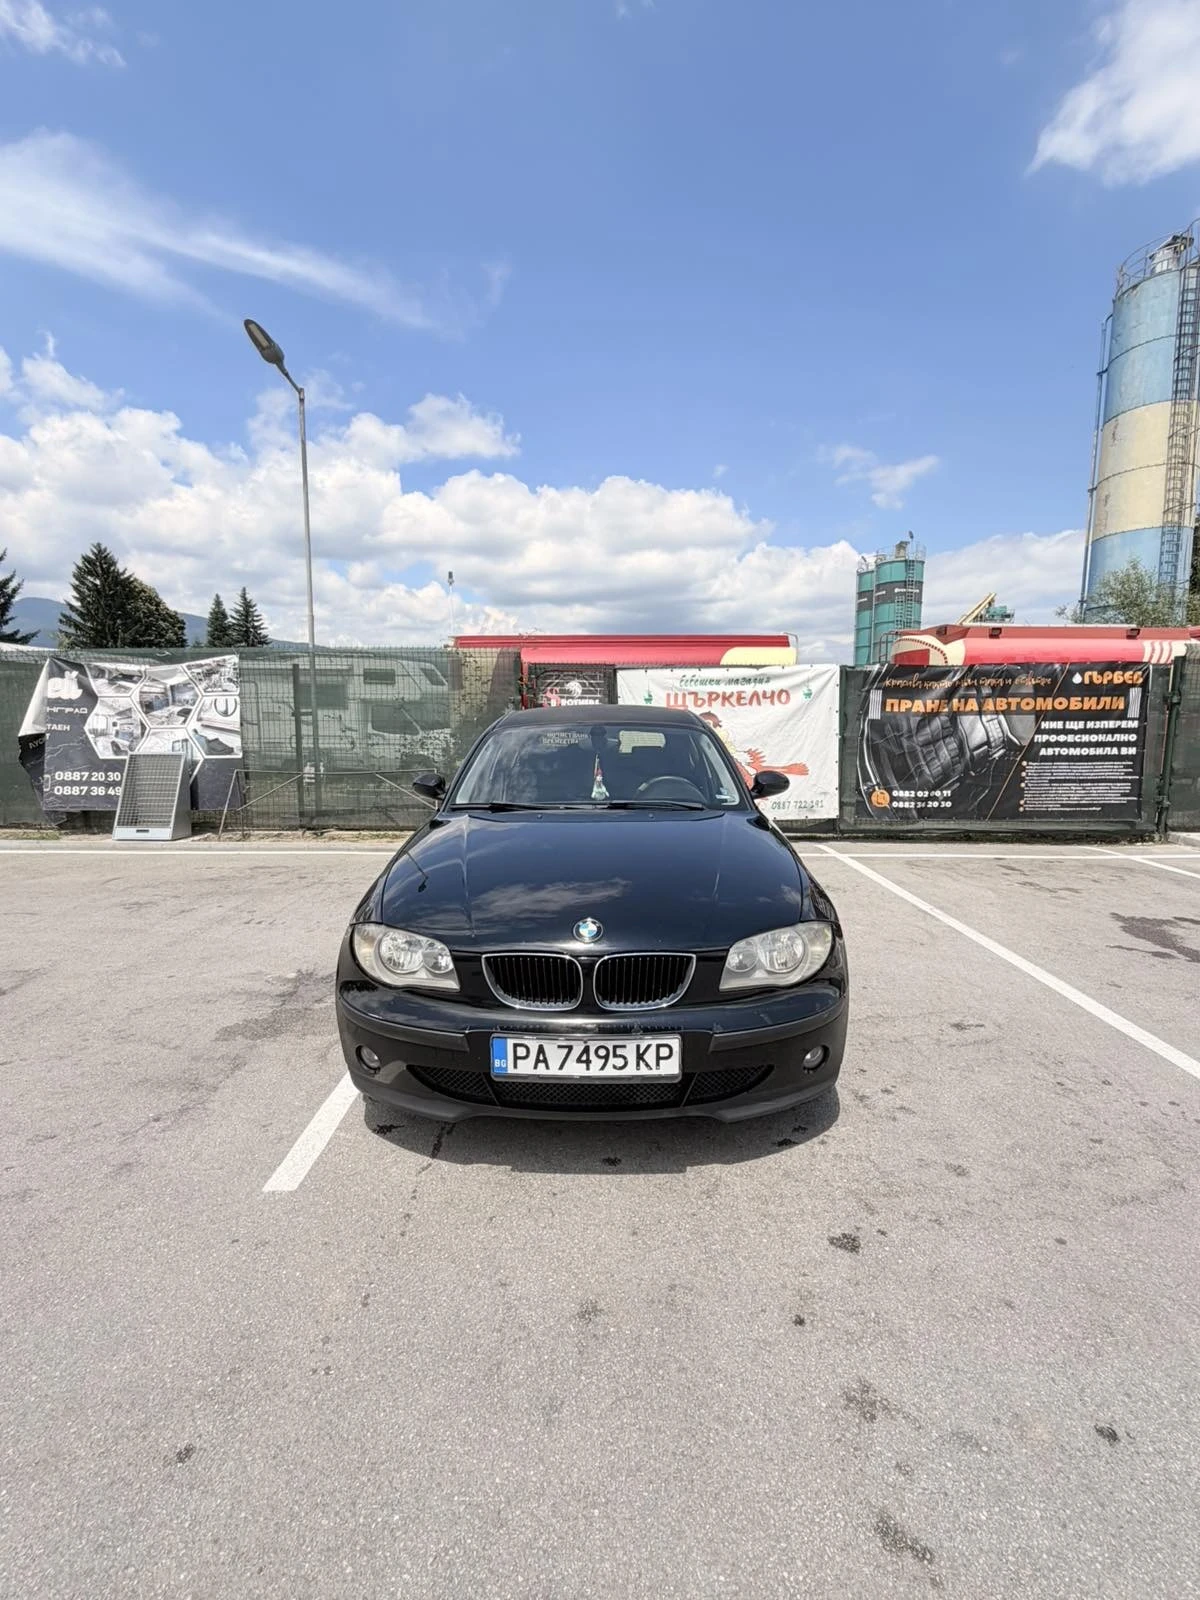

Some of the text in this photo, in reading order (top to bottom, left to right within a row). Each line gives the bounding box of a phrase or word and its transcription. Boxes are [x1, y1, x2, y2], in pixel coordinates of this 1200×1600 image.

[665, 689, 791, 710] ЩЪРКЕЛЧО
[885, 696, 1125, 712] ПРАНЕ НА АВТОМОБИЛИ
[1041, 720, 1139, 730] НИЕ ЩЕ ИЗПЕРЕМ
[1034, 734, 1138, 742] ПРОФЕСИОНАЛНО
[1039, 747, 1137, 756] АВТОМОБИЛА ВИ
[54, 771, 121, 781] 0887 20 30
[53, 786, 88, 795] 0887
[90, 786, 105, 795] 36
[512, 1042, 674, 1071] PA 7495 KP
[494, 1059, 507, 1068] BG
